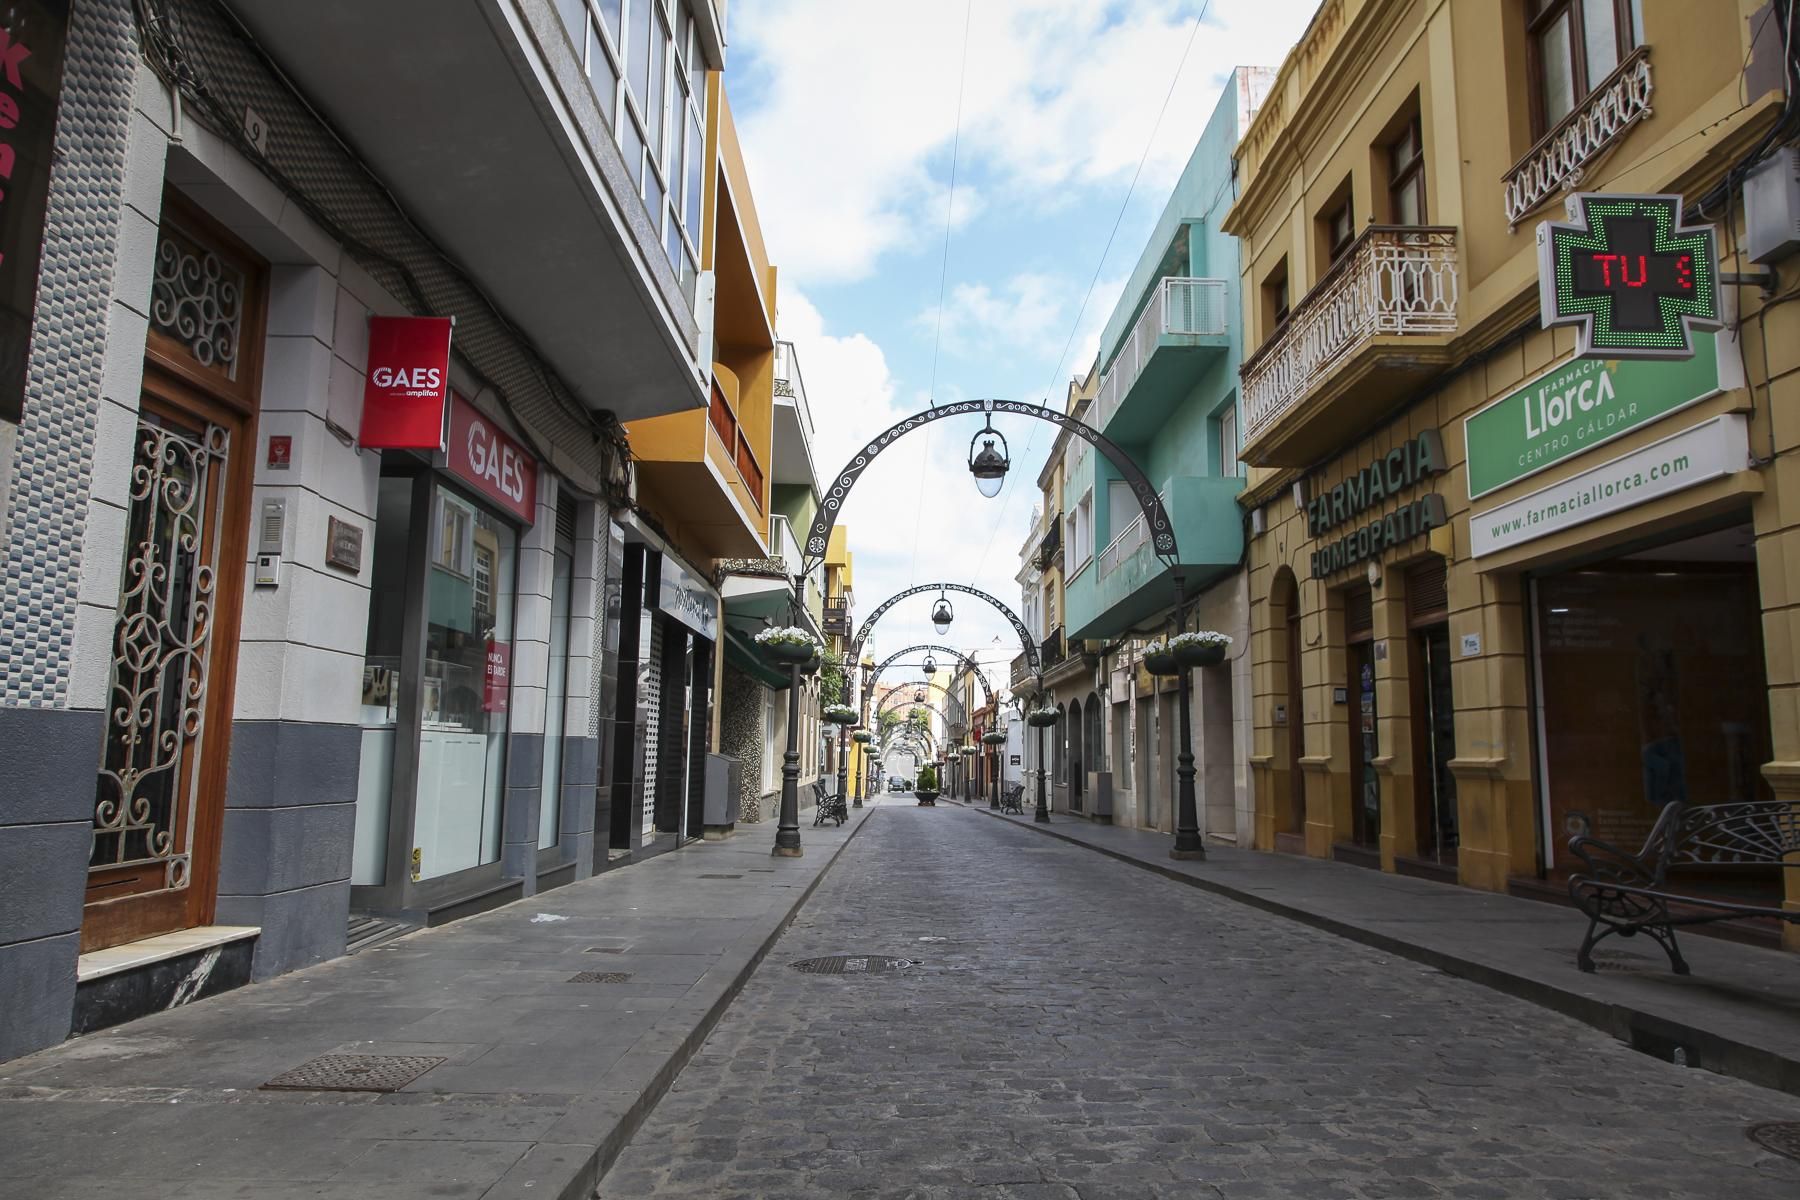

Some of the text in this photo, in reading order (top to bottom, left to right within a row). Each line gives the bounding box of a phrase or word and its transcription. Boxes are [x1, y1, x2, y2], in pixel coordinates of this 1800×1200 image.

[1592, 255, 1647, 287] TU
[373, 367, 440, 388] GAES
[406, 389, 438, 398] amplifon
[1545, 360, 1604, 395] FARMACIA
[468, 420, 524, 503] GAES
[1519, 434, 1569, 466] CENTRO
[1307, 430, 1448, 538] FARMACIA
[1491, 455, 1689, 538] www.farmaciallorca.com
[1311, 493, 1448, 579] HOMEOPATIA
[487, 664, 493, 675] ES
[488, 652, 503, 664] NUNCA
